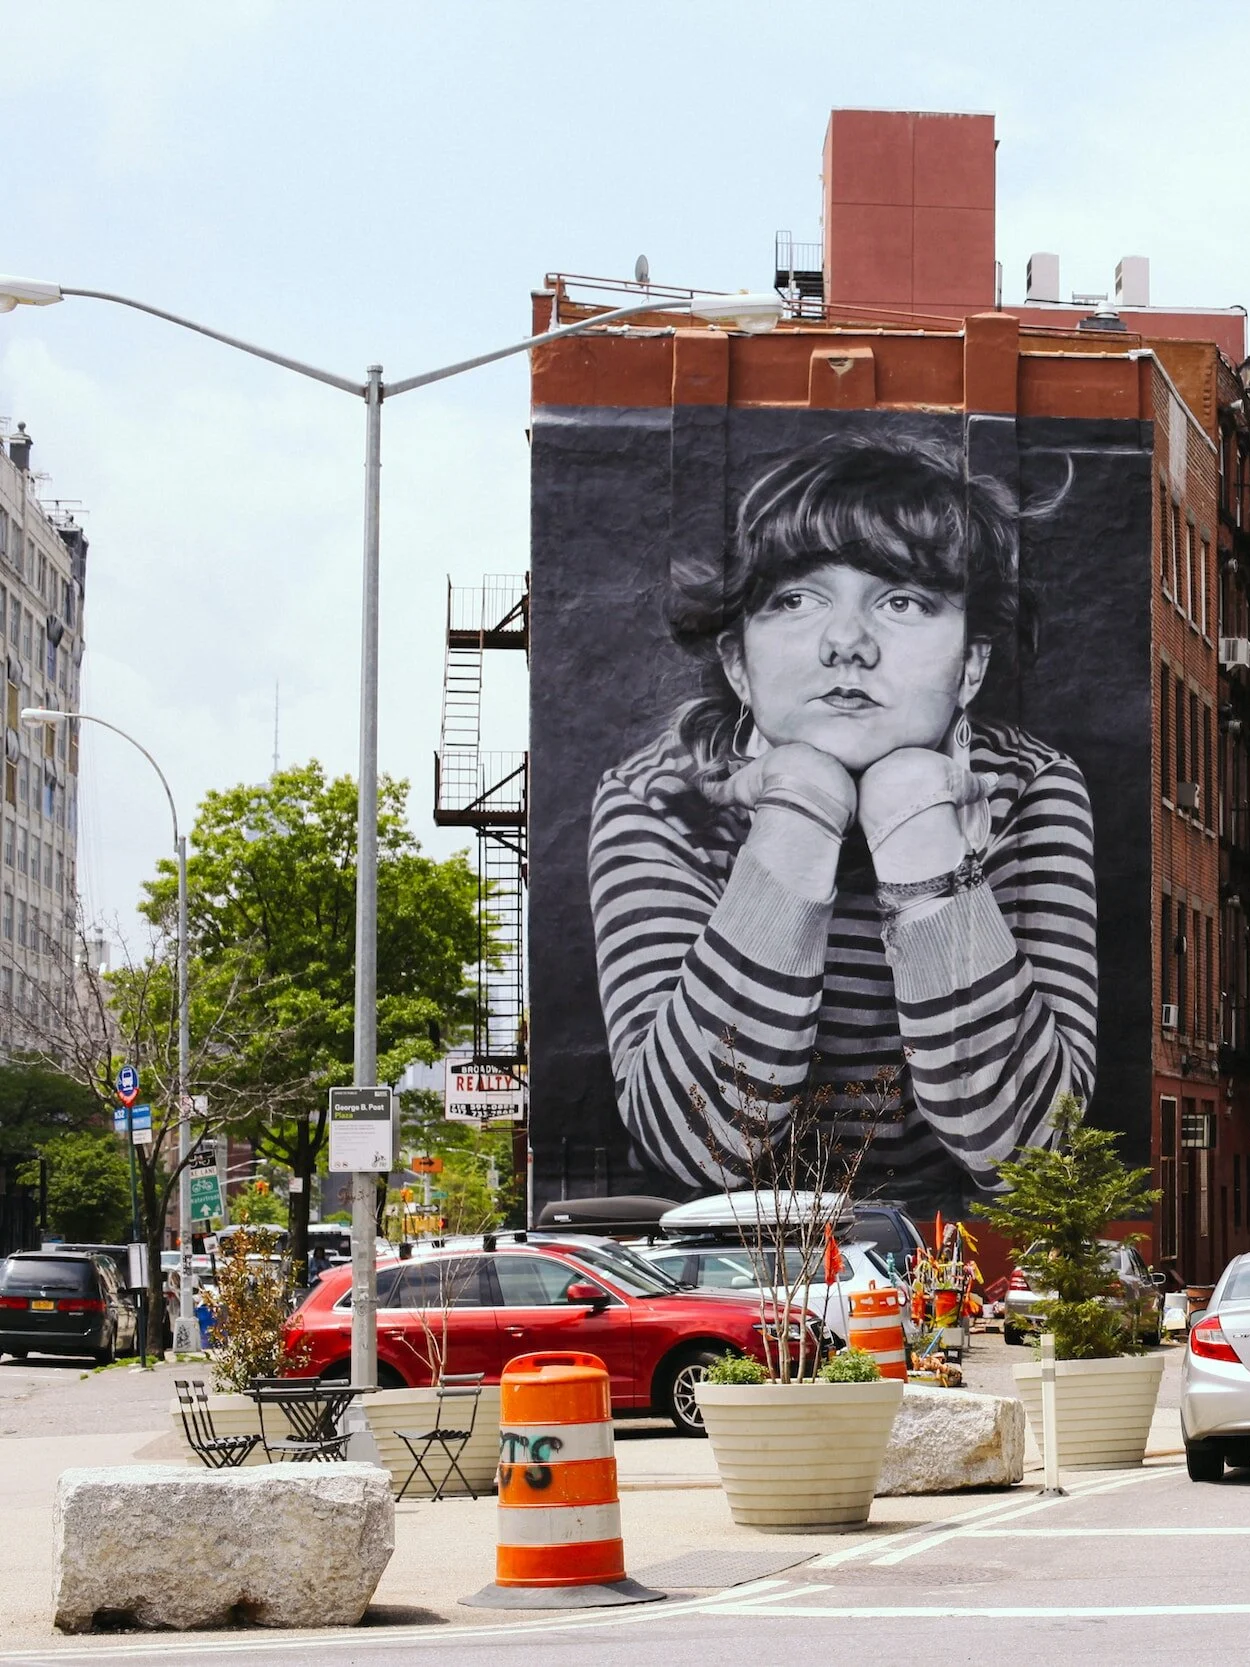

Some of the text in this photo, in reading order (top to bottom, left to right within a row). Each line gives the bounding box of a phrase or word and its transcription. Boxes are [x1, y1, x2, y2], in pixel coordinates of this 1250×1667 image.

[461, 1065, 509, 1074] BROADW
[456, 1075, 513, 1091] REALTY
[334, 1103, 385, 1112] George B. Post
